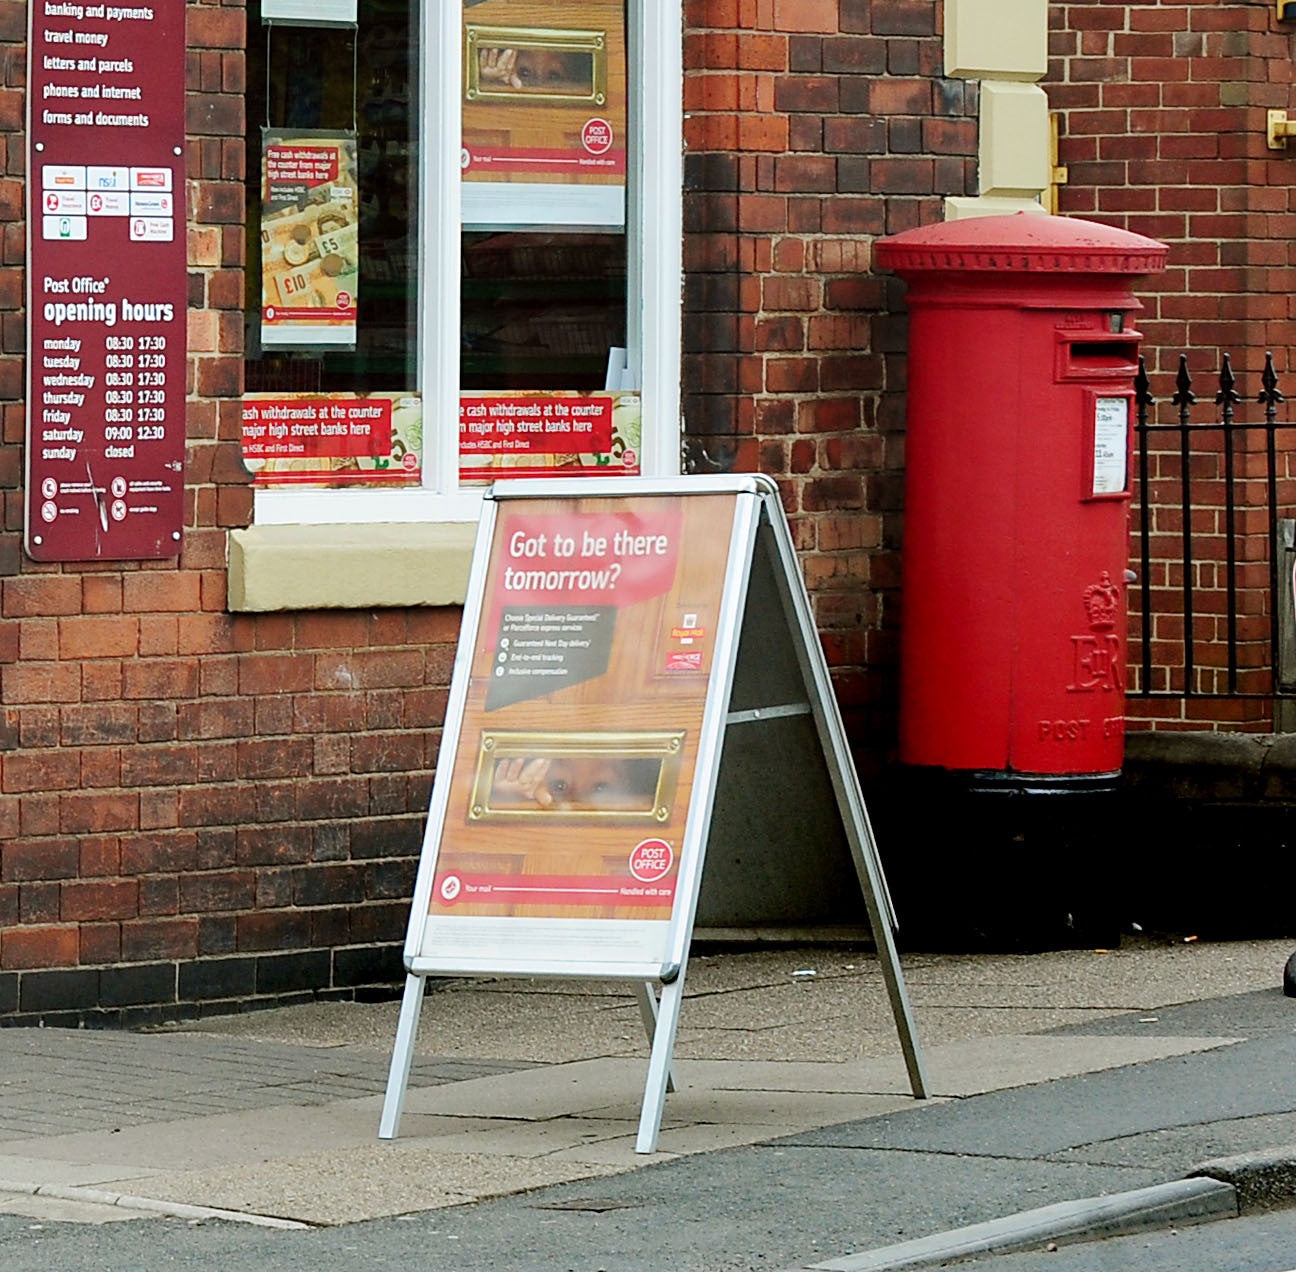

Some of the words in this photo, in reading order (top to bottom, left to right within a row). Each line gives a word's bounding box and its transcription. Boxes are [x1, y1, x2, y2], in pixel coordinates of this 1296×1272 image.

[45, 1, 83, 19] banking
[85, 4, 105, 18] and
[107, 7, 154, 21] payments
[44, 29, 73, 43] travel
[75, 33, 108, 47] money
[43, 55, 75, 70] letters
[77, 57, 96, 71] and
[98, 58, 133, 74] parcels
[43, 83, 79, 99] phones
[81, 84, 100, 98] and
[102, 84, 142, 100] internet
[43, 109, 72, 124] forms
[74, 111, 93, 125] and
[95, 111, 149, 127] documents
[589, 126, 606, 135] POST
[585, 135, 609, 145] OFFICE
[322, 238, 339, 254] £5
[44, 277, 70, 293] Post
[284, 274, 306, 294] £10
[44, 297, 116, 326] opening
[122, 298, 174, 321] hours
[43, 337, 81, 352] monday
[106, 336, 133, 350] 08:30
[138, 336, 166, 350] 17:30
[43, 355, 80, 371] tuesday
[106, 355, 133, 368] 08:30
[138, 355, 166, 368] 17:30
[43, 373, 95, 388] wednesday
[106, 372, 133, 386] 08:30
[138, 372, 165, 386] 17:30
[43, 391, 85, 407] thursday
[106, 390, 133, 404] 08:30
[138, 390, 165, 404] 17:30
[43, 409, 70, 425] friday
[105, 408, 133, 422] 08:30
[137, 408, 165, 422] 17:30
[242, 406, 259, 420] ash
[261, 405, 317, 420] withdrawals
[319, 406, 328, 419] at
[330, 405, 346, 418] the
[348, 406, 383, 418] counter
[467, 403, 487, 416] cash
[489, 403, 541, 416] withdrawals
[543, 404, 553, 416] at
[555, 403, 569, 416] the
[571, 403, 604, 416] counter
[42, 427, 83, 443] saturday
[105, 426, 132, 440] 09:00
[137, 426, 164, 439] 12:30
[269, 422, 288, 439] high
[291, 423, 318, 436] street
[320, 422, 348, 435] banks
[350, 421, 371, 435] here
[469, 419, 494, 436] major
[496, 419, 515, 436] high
[517, 420, 543, 432] street
[545, 419, 570, 432] banks
[573, 418, 593, 432] here
[42, 446, 76, 461] sunday
[105, 445, 134, 458] closed
[510, 531, 547, 557] Got
[554, 532, 575, 557] to
[581, 530, 607, 557] be
[613, 530, 668, 556] there
[504, 563, 622, 590] tomorrow?
[1039, 719, 1090, 742] POST
[641, 848, 665, 859] POST
[634, 859, 666, 870] OFFICE
